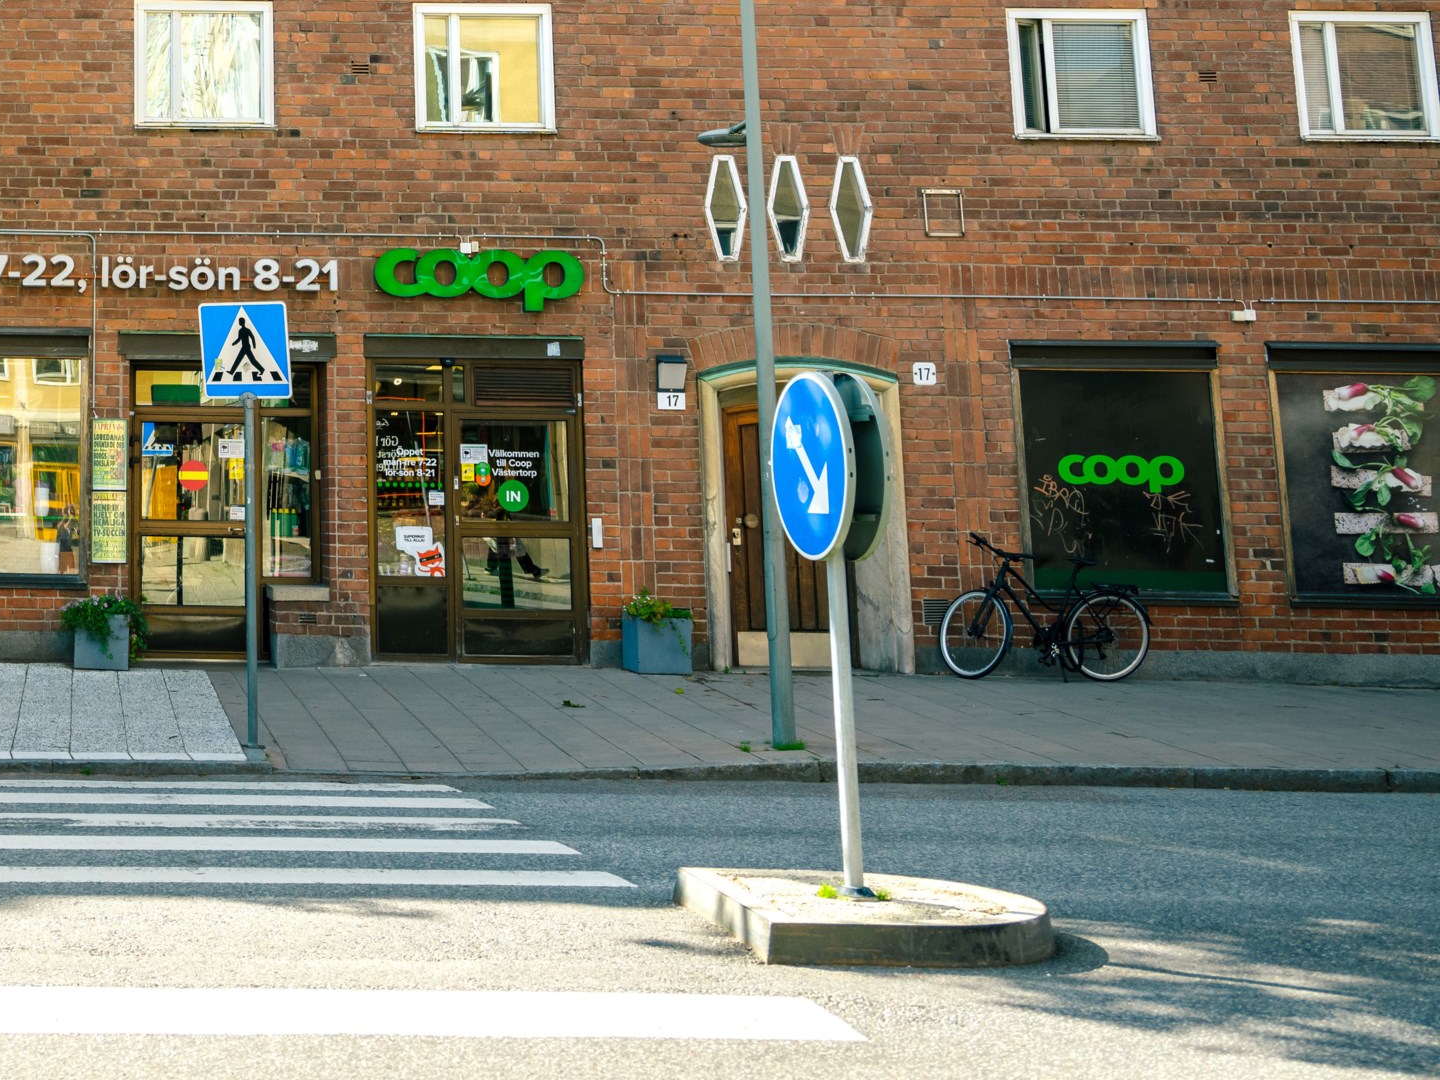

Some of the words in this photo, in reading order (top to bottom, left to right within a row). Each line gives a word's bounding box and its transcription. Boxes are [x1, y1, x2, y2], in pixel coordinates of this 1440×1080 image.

[100, 256, 241, 292] lör-sön
[252, 258, 340, 292] 8-21
[373, 247, 586, 313] coop
[918, 367, 931, 380] 17
[666, 394, 679, 407] 17
[396, 445, 424, 457] Öppet
[488, 449, 540, 458] Välkommen
[496, 459, 507, 467] till
[508, 459, 532, 469] Coop
[416, 468, 436, 477] 8-21
[491, 468, 538, 479] Västertorp
[1057, 454, 1185, 493] coop
[505, 490, 521, 503] IN
